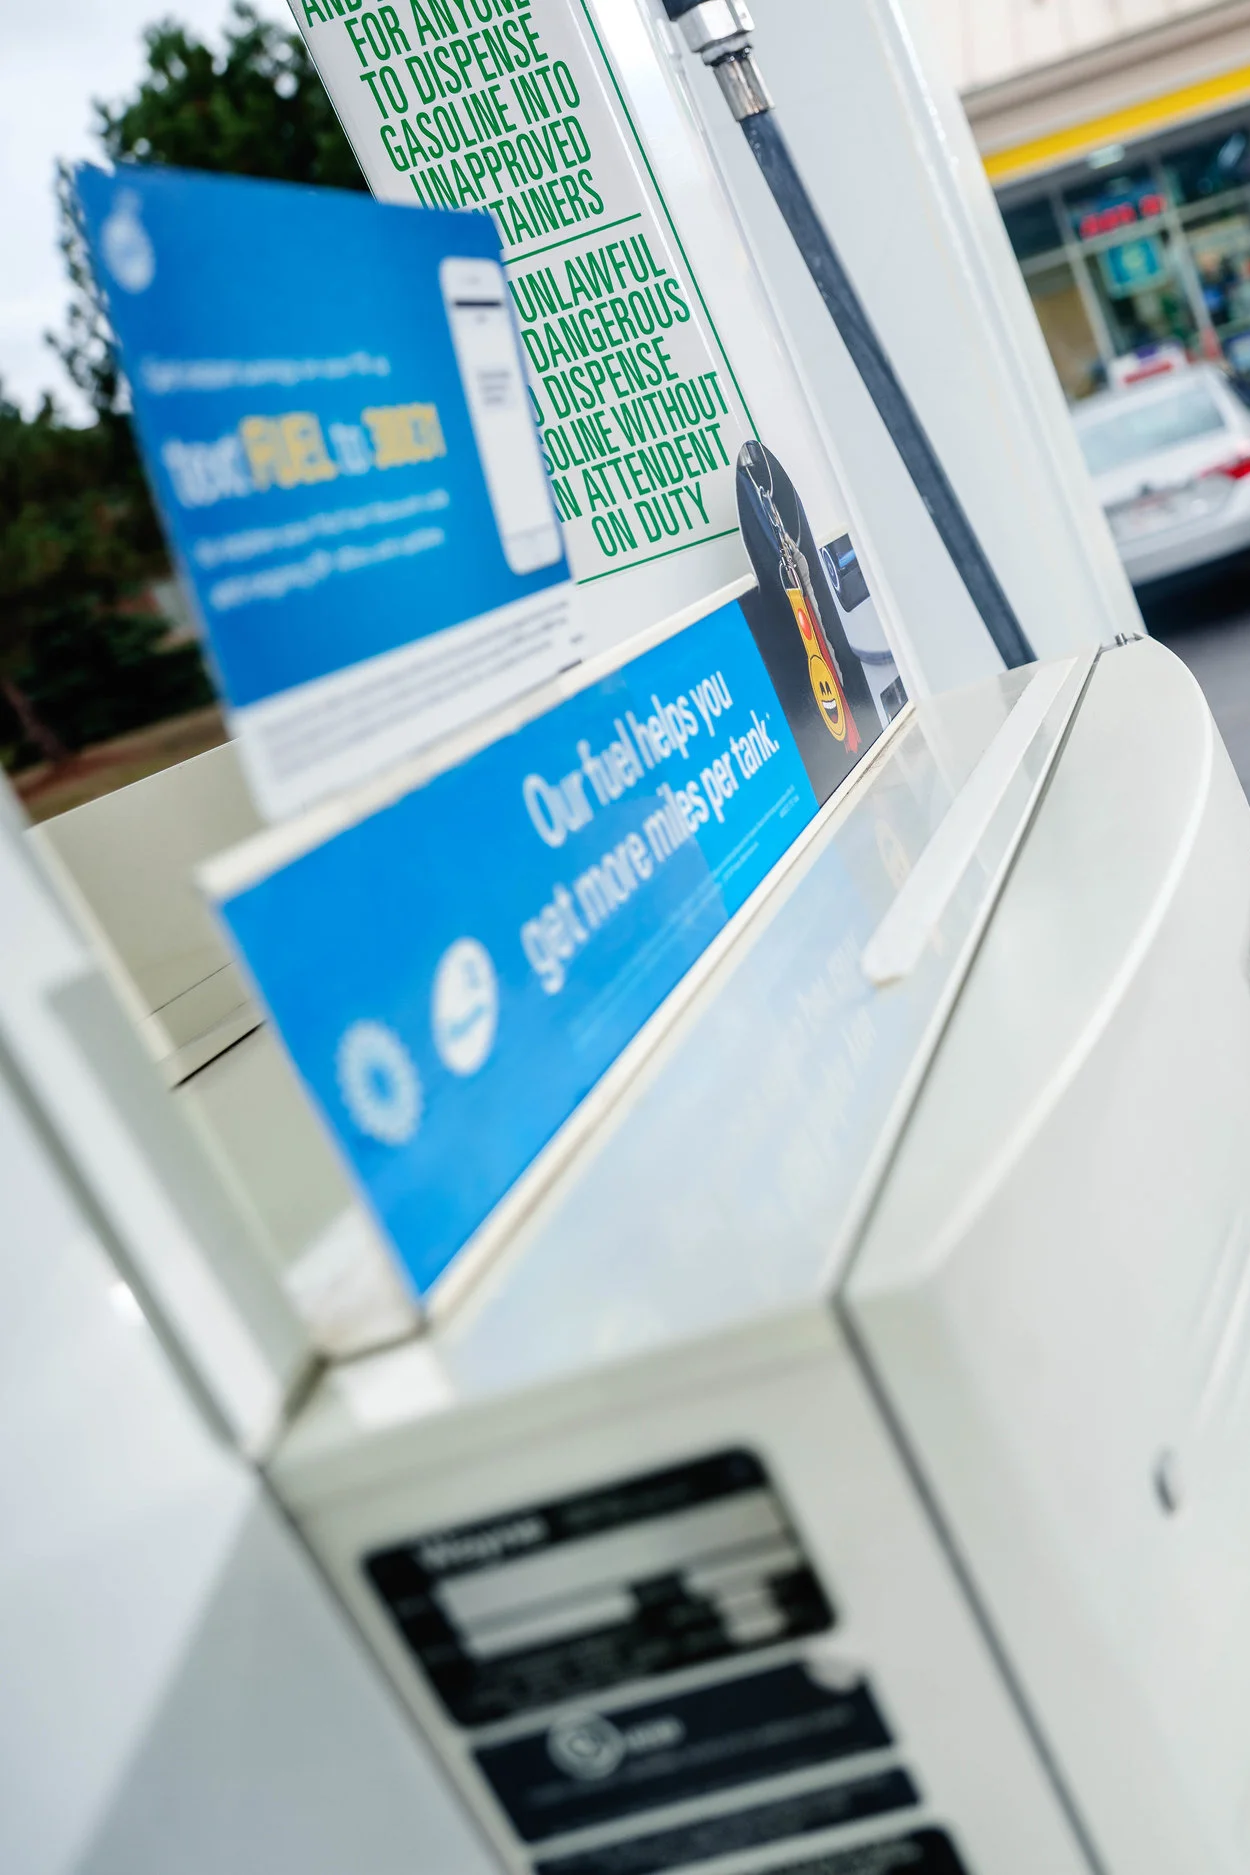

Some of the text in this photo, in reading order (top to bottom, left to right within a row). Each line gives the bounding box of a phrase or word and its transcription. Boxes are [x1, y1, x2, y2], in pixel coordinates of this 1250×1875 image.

[344, 5, 411, 67] FOR
[410, 0, 531, 46] ANYO
[360, 12, 549, 119] TO DISPENSE
[380, 60, 580, 172] GASOLINE INTO
[410, 115, 591, 211] UNAPPROVED
[471, 168, 605, 250] TAINERS
[508, 233, 667, 323] UNLAWFUL
[520, 277, 691, 374] DANGEROUS
[534, 410, 620, 476] OLINE
[610, 371, 729, 448] WITHOUT
[542, 336, 679, 420] DISPENSE
[551, 423, 731, 523] N ATTENDENT
[591, 481, 710, 557] ON DUTY
[522, 670, 734, 849] Our fuel helps you
[519, 882, 588, 995] get
[572, 831, 654, 927] more
[642, 780, 710, 863] miles
[699, 751, 739, 824] per
